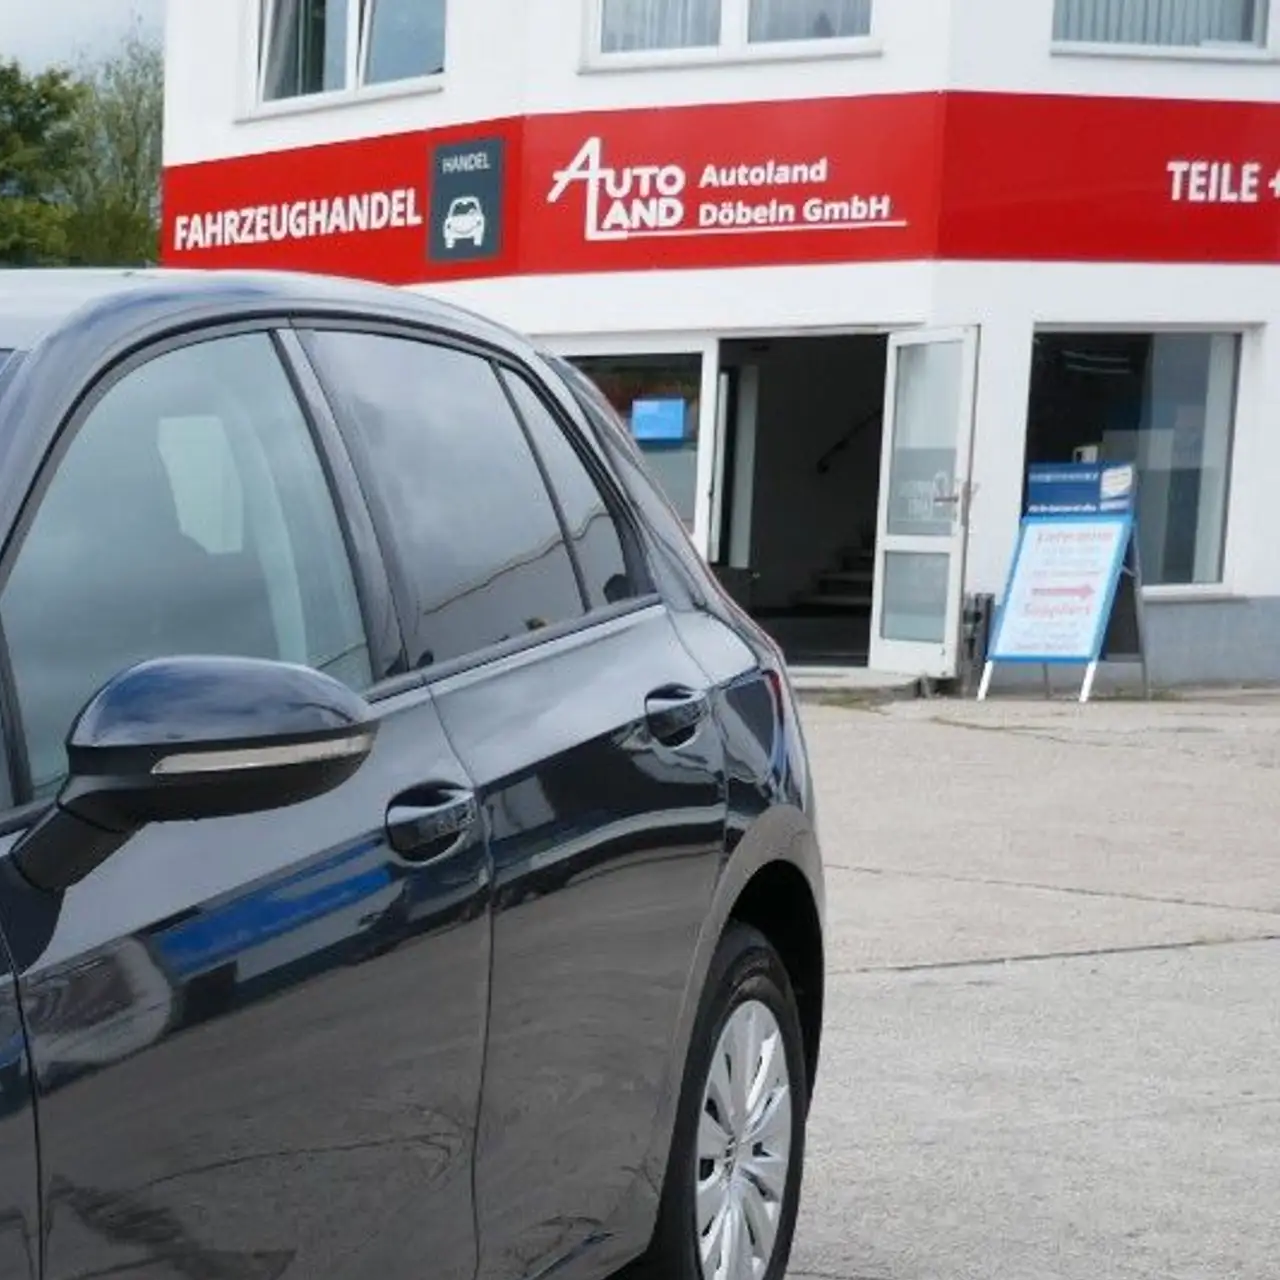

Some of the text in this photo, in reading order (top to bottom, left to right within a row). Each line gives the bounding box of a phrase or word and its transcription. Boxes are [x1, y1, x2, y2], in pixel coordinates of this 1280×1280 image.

[441, 151, 491, 174] HANDEL
[698, 157, 828, 189] Autoland
[1166, 161, 1261, 203] TEILE
[173, 187, 423, 250] FAHRZEUGHANDEL
[698, 194, 892, 228] Döbeln GmbH
